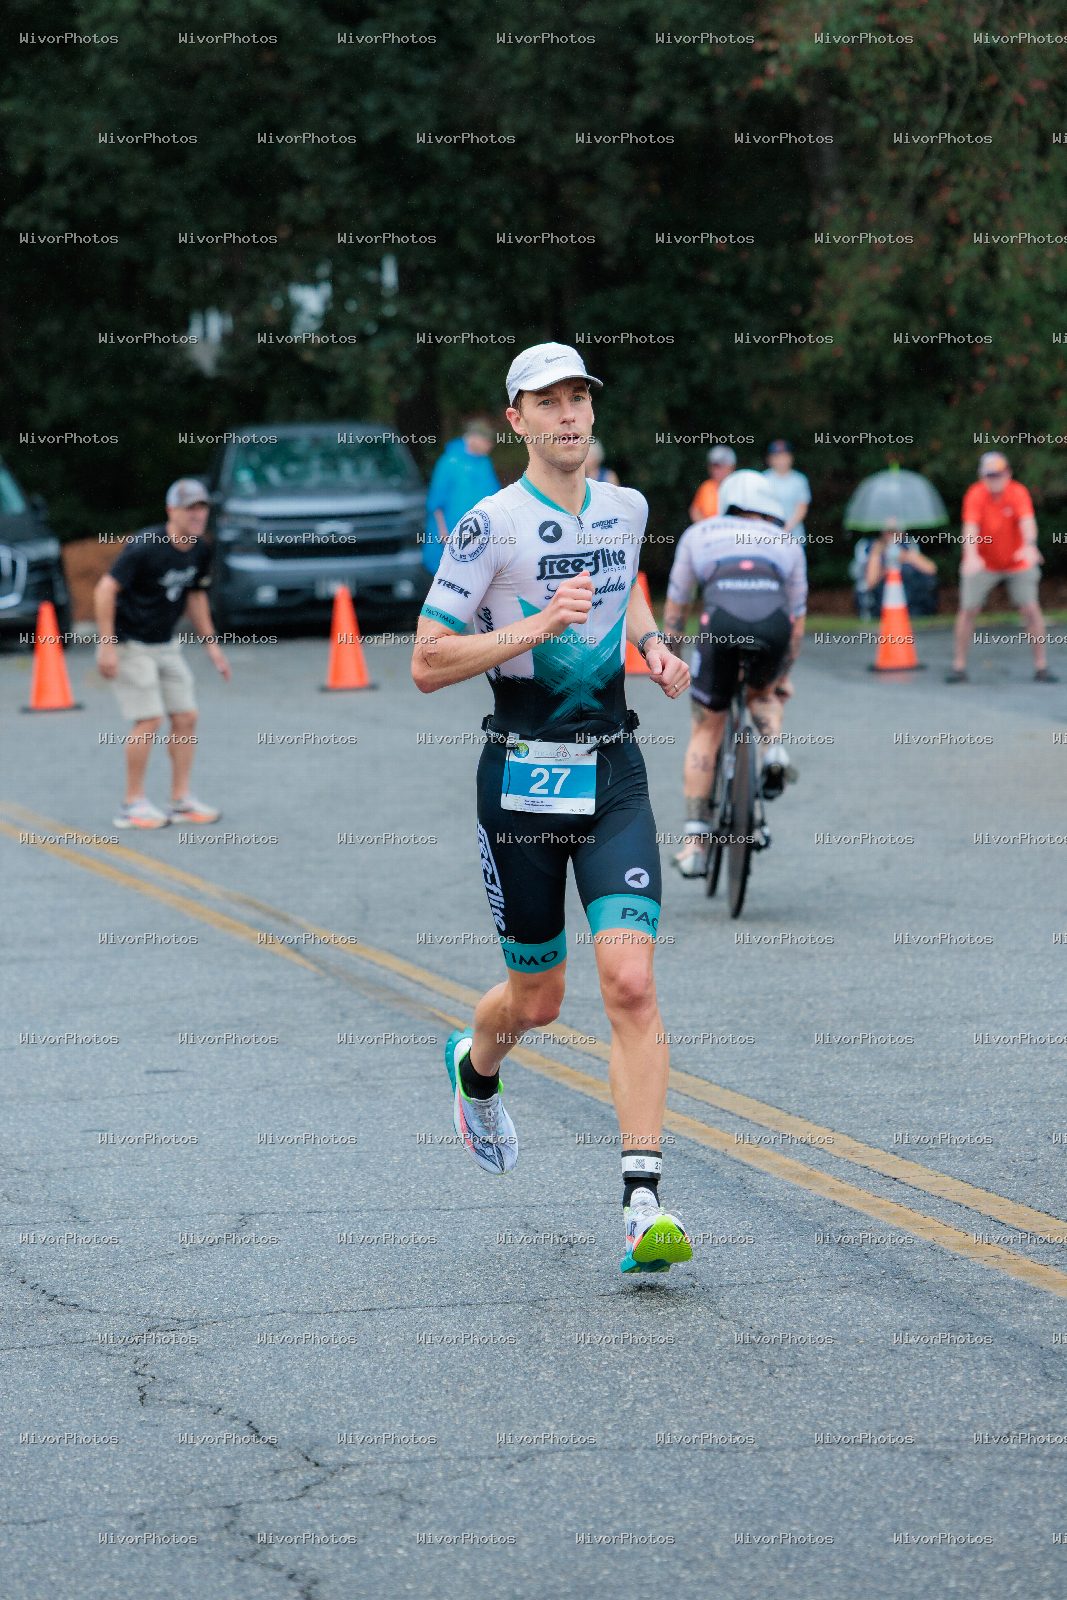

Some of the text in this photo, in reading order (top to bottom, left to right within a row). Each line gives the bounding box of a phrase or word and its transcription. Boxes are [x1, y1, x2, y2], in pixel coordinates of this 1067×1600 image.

[537, 548, 626, 580] free-flite
[437, 578, 472, 598] TREK
[528, 767, 571, 795] 27
